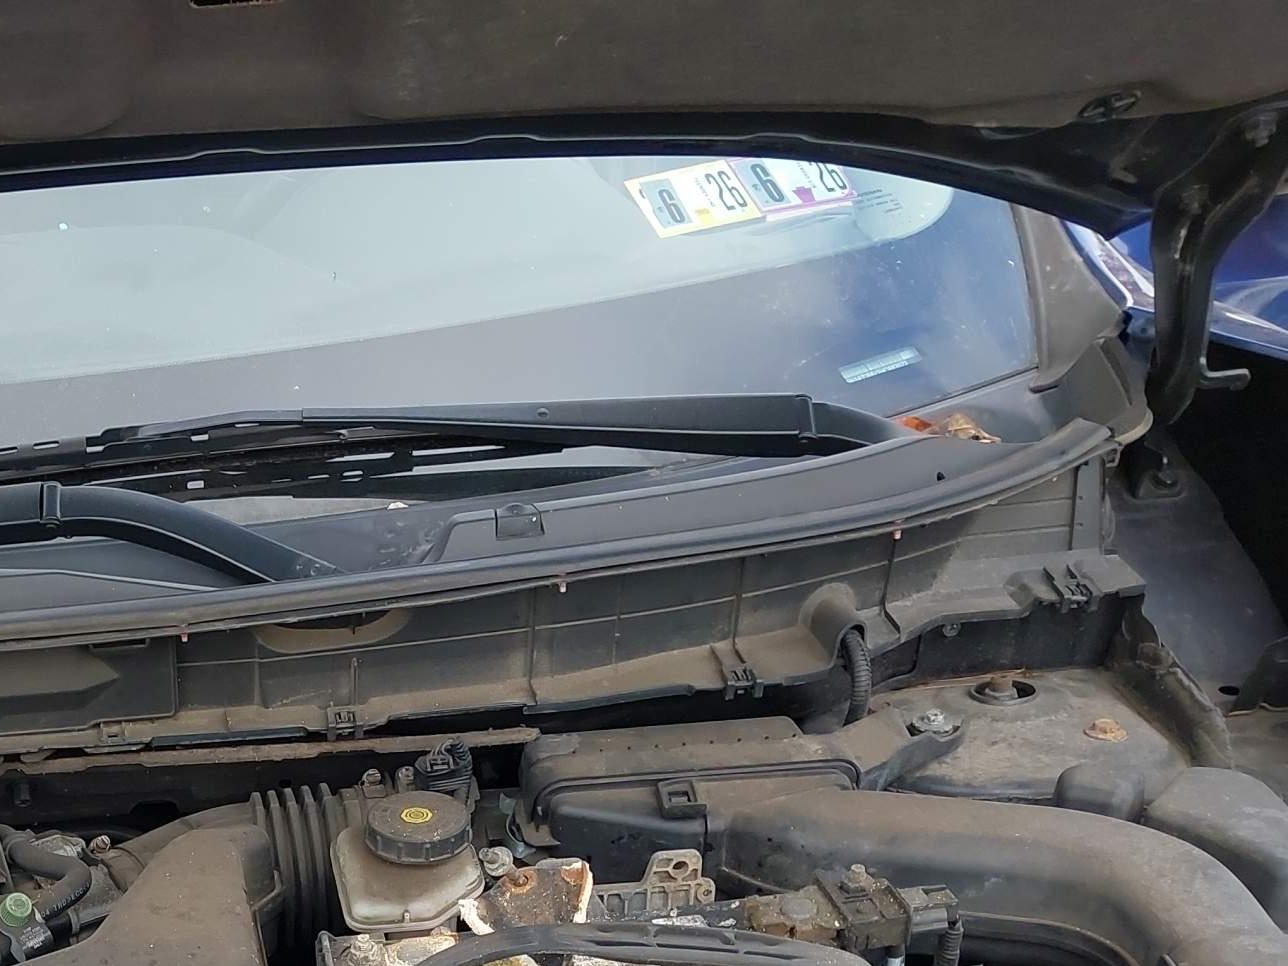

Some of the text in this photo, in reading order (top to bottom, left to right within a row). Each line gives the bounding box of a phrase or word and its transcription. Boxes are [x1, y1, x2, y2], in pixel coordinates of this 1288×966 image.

[704, 170, 748, 211] 26
[750, 163, 785, 201] 6
[810, 161, 848, 193] 26
[658, 188, 686, 223] 6
